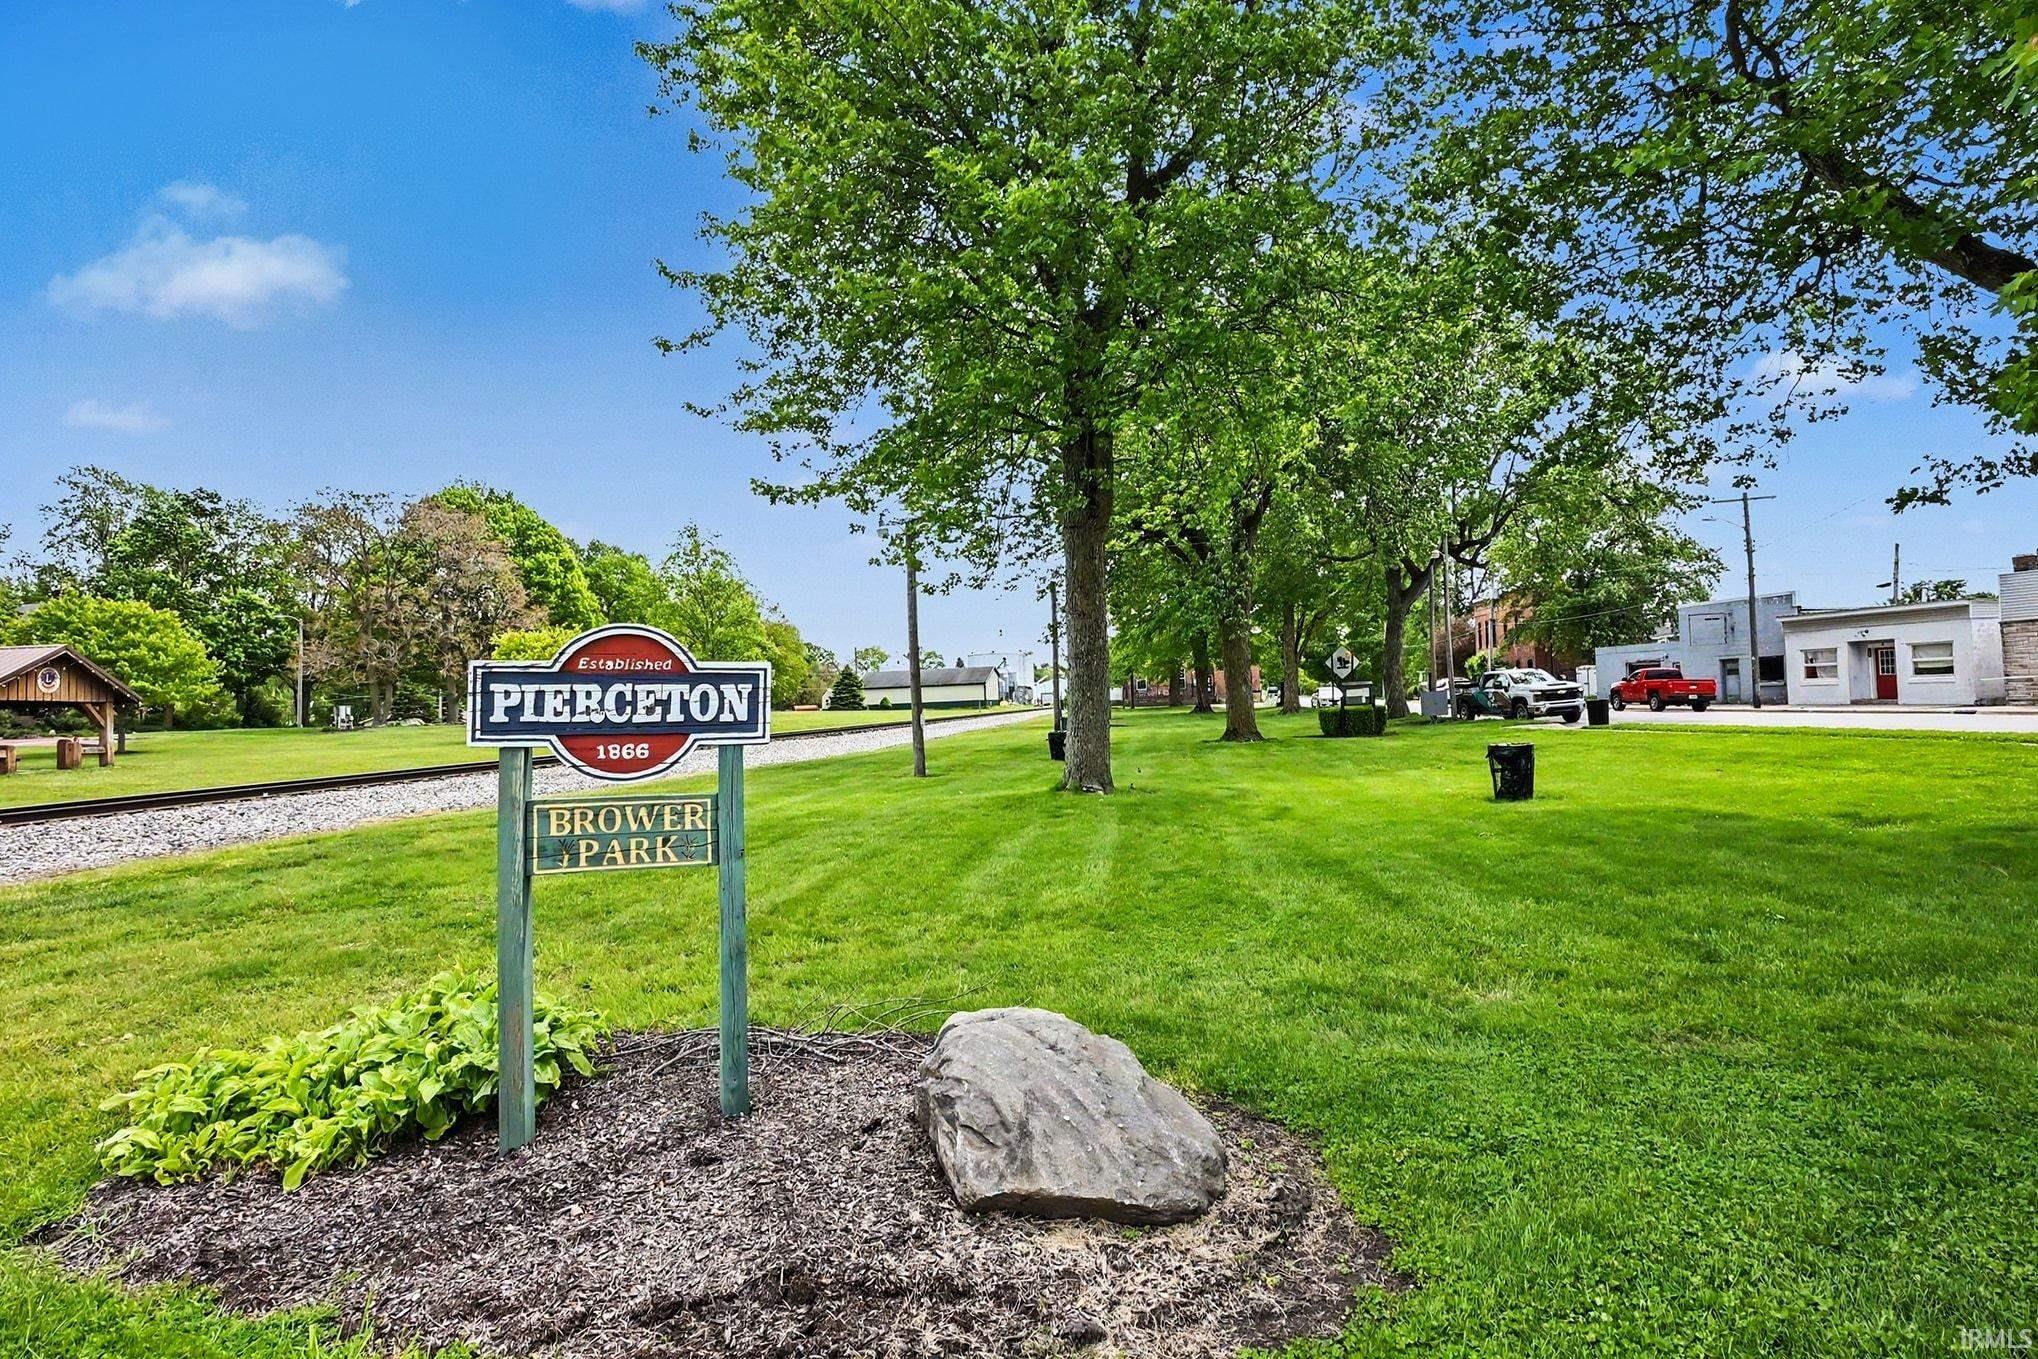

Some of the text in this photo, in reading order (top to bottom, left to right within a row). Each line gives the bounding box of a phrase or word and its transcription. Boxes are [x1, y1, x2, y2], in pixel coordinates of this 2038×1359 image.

[577, 657, 673, 671] Established
[489, 683, 753, 724] PIERCETON
[596, 743, 650, 760] 1866
[549, 802, 706, 837] BROWER
[578, 835, 679, 867] PARK
